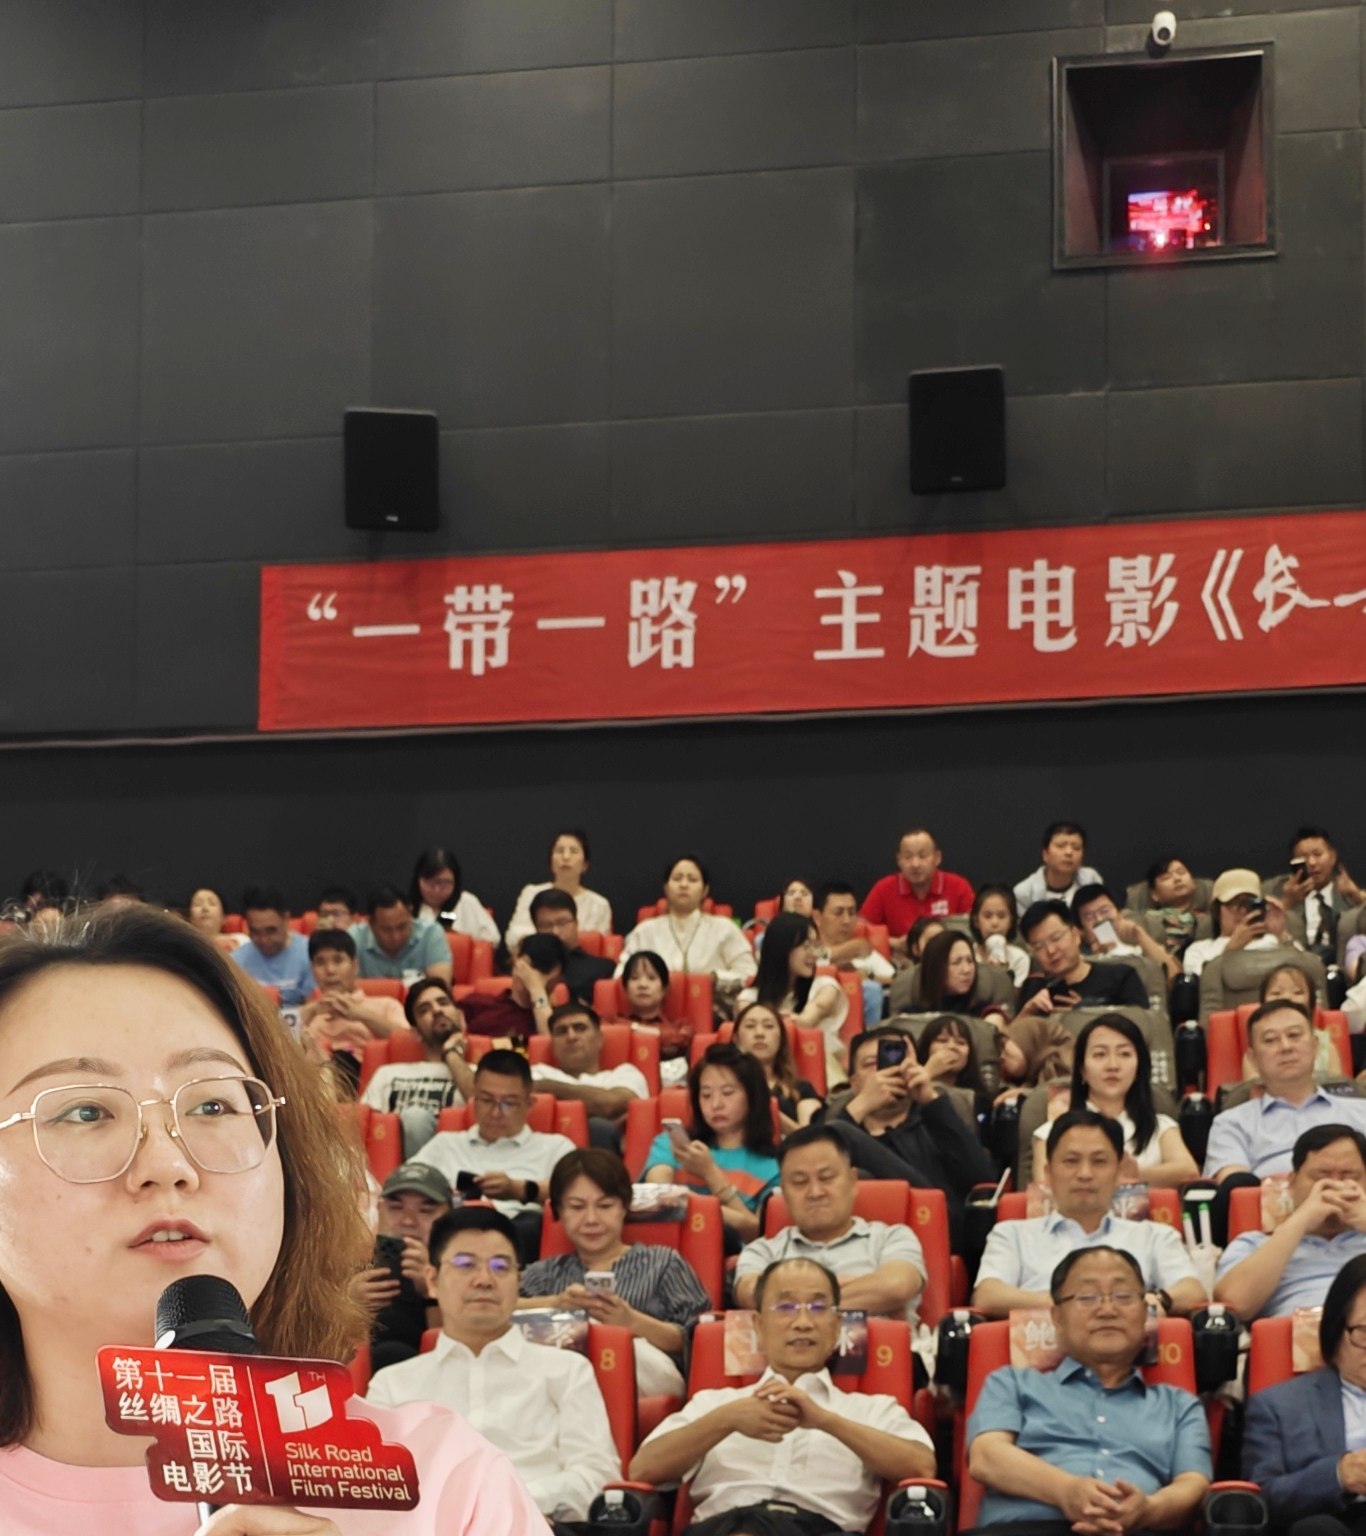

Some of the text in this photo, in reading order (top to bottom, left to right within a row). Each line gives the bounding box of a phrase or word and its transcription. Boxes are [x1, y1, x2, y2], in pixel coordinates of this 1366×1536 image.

[690, 1213, 705, 1233] 8
[600, 1349, 616, 1372] 8
[876, 1345, 893, 1368] 9
[1158, 1343, 1182, 1365] 10
[112, 1357, 237, 1395] 第十一届
[119, 1391, 243, 1428] 丝绸之路
[186, 1427, 250, 1461] 国际
[285, 1441, 373, 1463] Silk Road
[162, 1460, 252, 1495] 电影节
[287, 1460, 405, 1482] International
[291, 1479, 411, 1501] Film Festival
